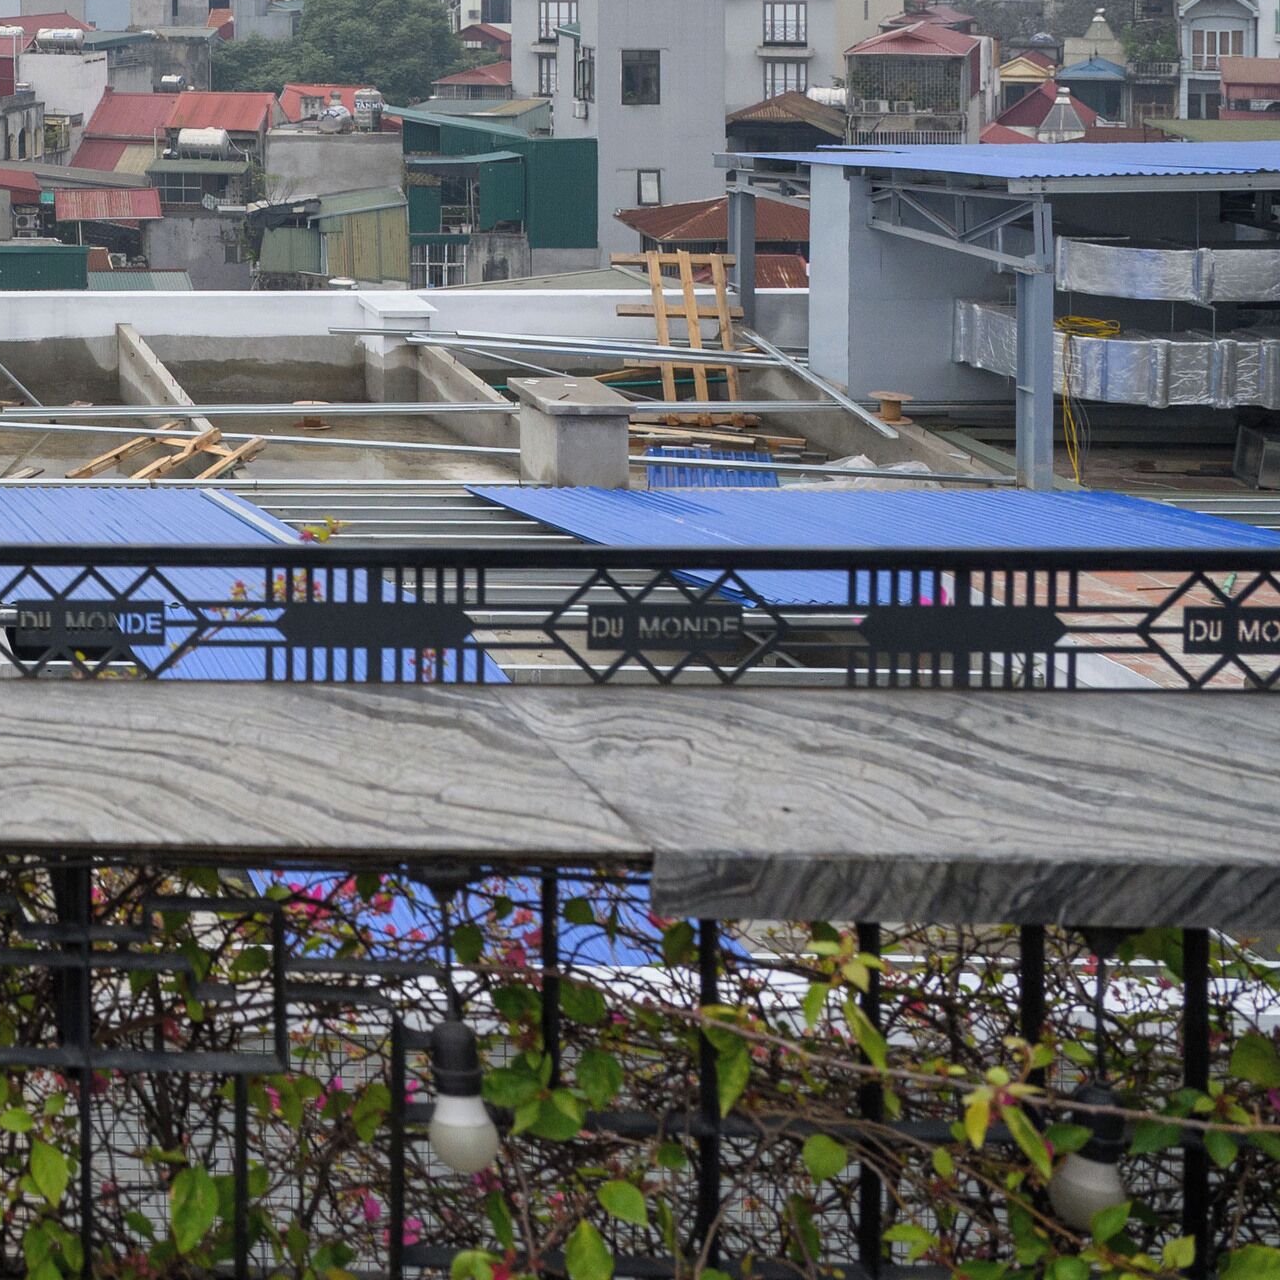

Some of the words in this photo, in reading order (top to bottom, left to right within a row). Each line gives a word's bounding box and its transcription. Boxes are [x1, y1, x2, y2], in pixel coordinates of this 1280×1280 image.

[20, 610, 51, 629] DU
[65, 610, 163, 634] MONDE
[592, 616, 624, 639] DU
[639, 616, 739, 639] MONDE
[1189, 619, 1222, 642] DU
